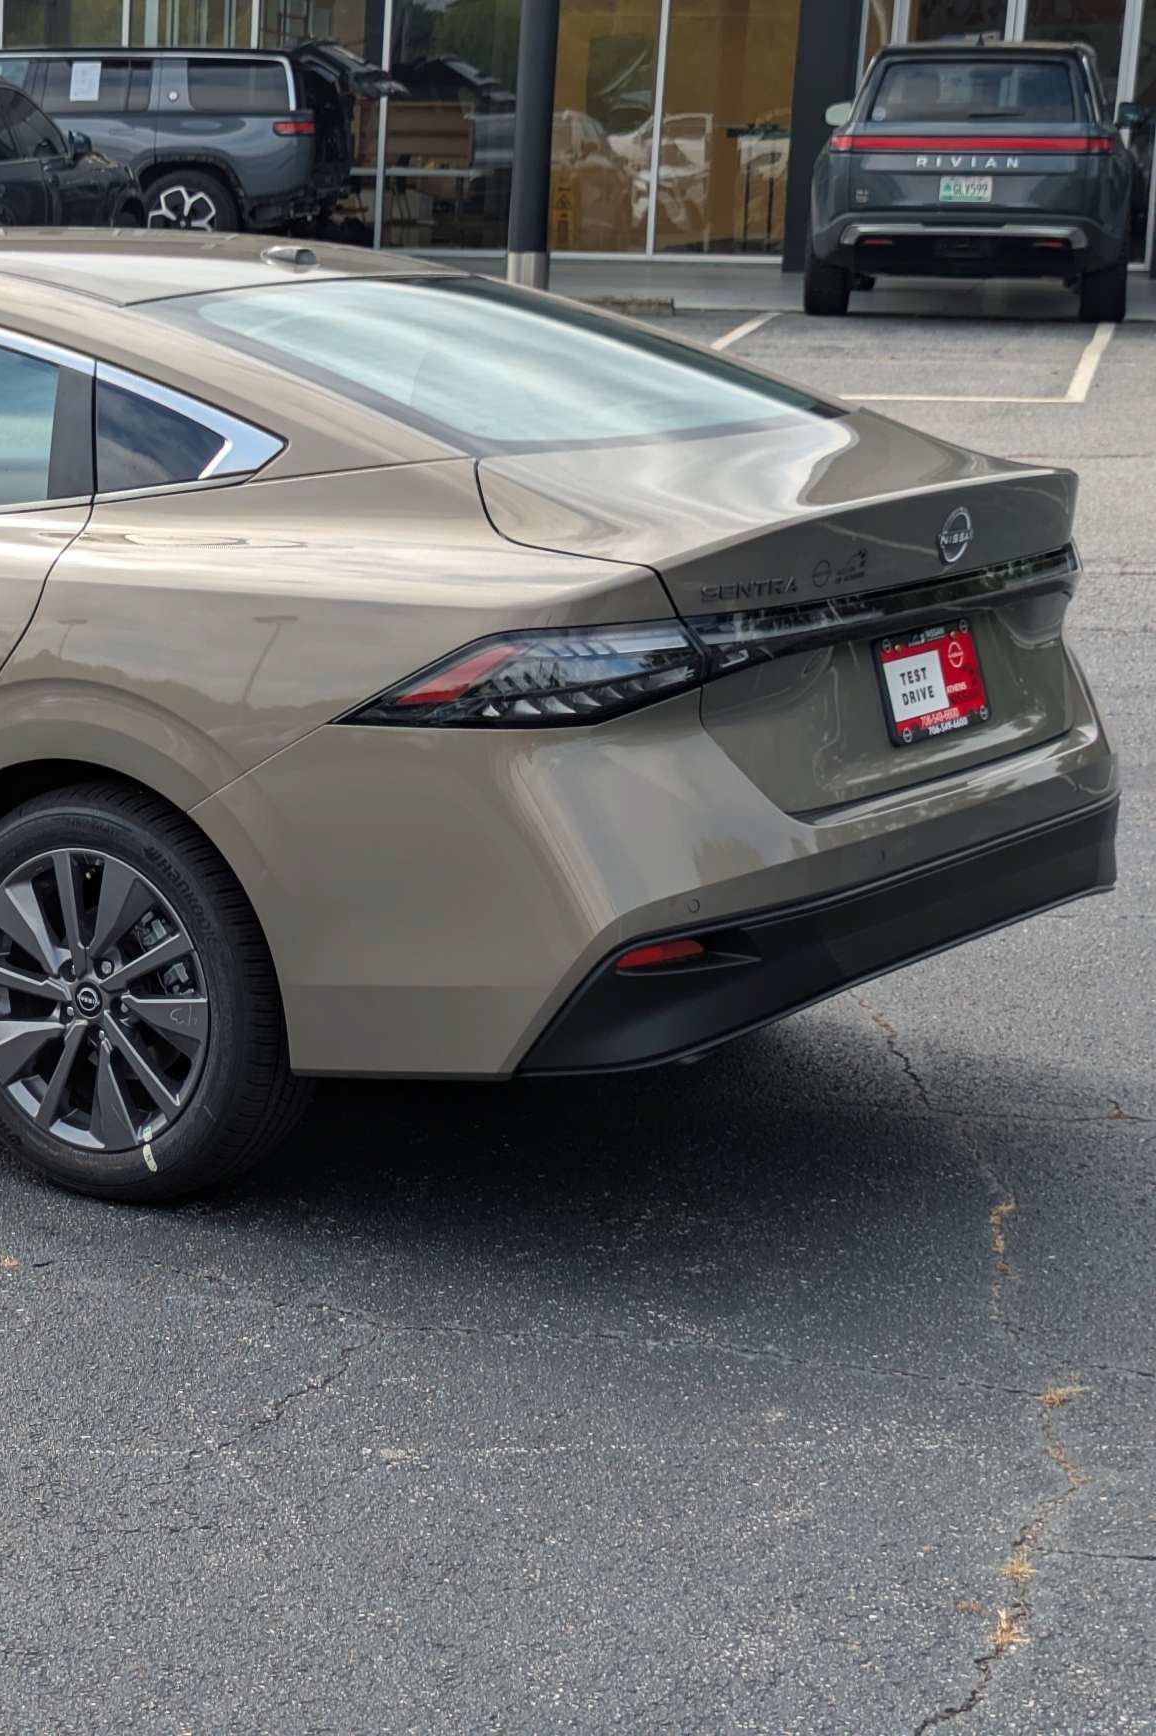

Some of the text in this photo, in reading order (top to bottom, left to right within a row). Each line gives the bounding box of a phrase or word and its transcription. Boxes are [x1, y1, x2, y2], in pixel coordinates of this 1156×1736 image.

[916, 155, 1019, 169] RIVIAN
[700, 577, 798, 603] SENTRA
[900, 667, 927, 686] TEST
[901, 685, 935, 706] DRIVE
